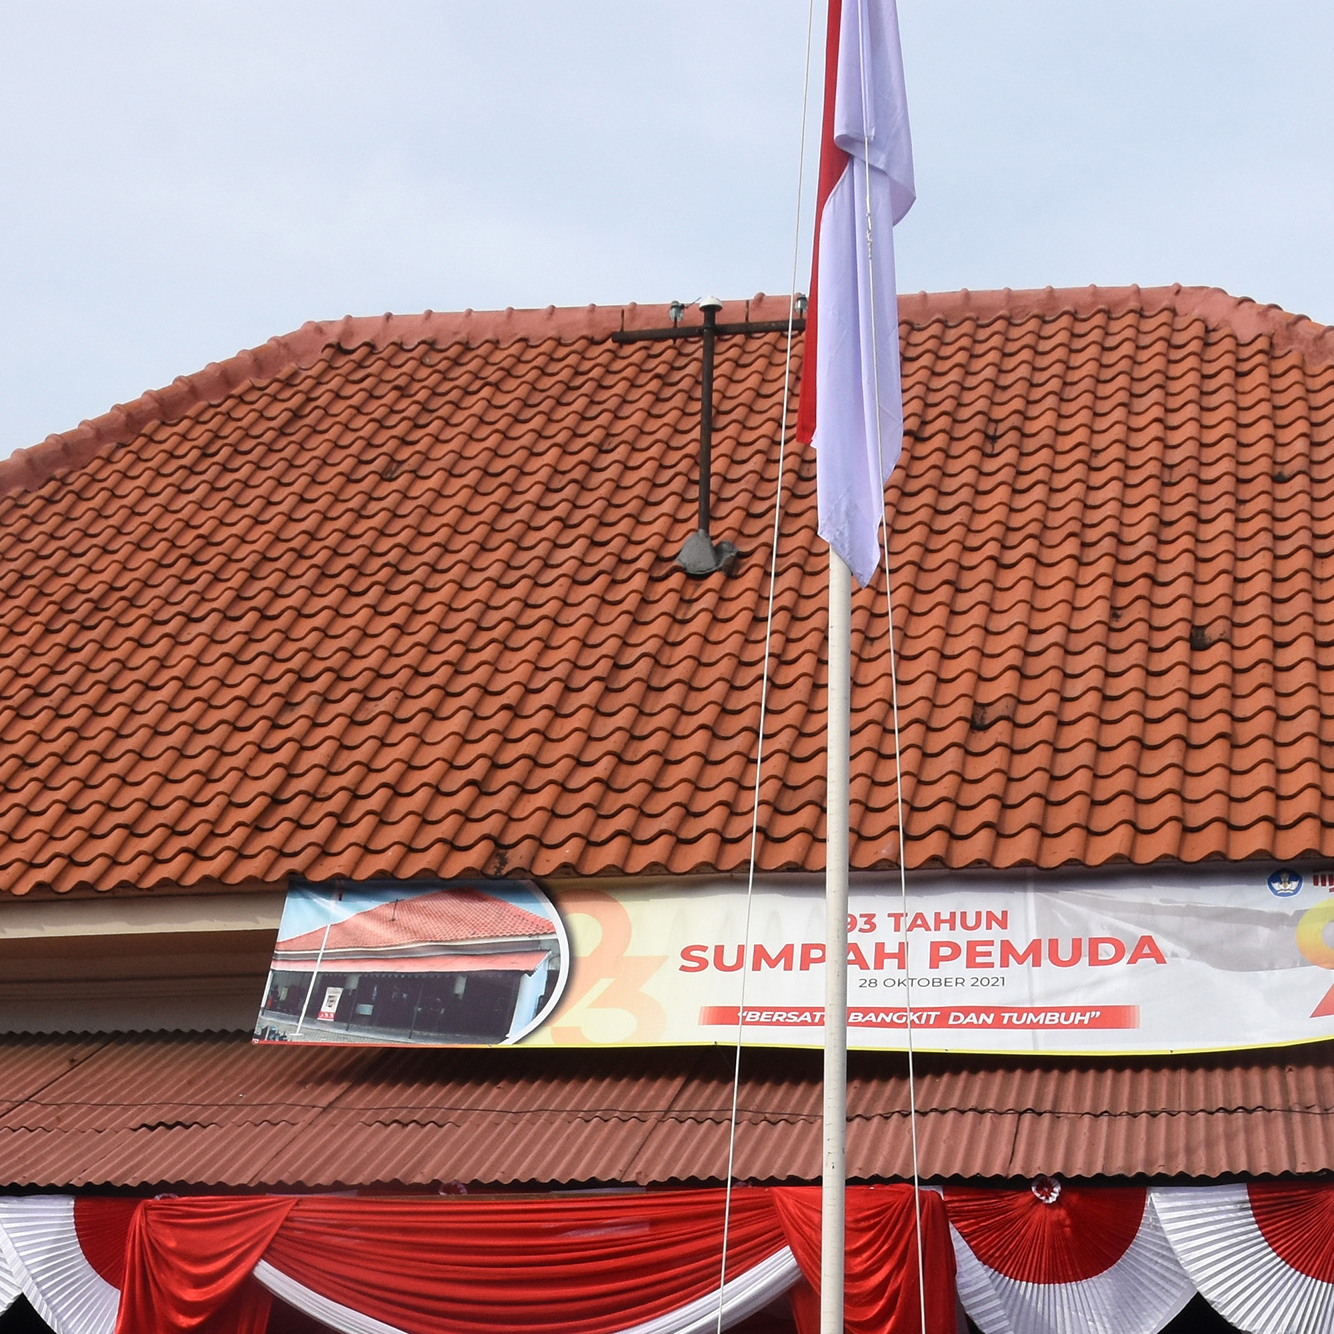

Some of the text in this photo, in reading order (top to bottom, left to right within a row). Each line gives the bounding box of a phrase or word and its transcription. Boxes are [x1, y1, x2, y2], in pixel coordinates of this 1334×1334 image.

[887, 909, 1008, 933] TAHUN
[678, 934, 1168, 973] SUMPAH PEMUDA
[858, 976, 1006, 989] 28 OKTOBER 2021
[848, 1011, 941, 1024] BANGKIT
[948, 1012, 995, 1025] DAN
[1001, 1010, 1101, 1025] TUMBUH”
